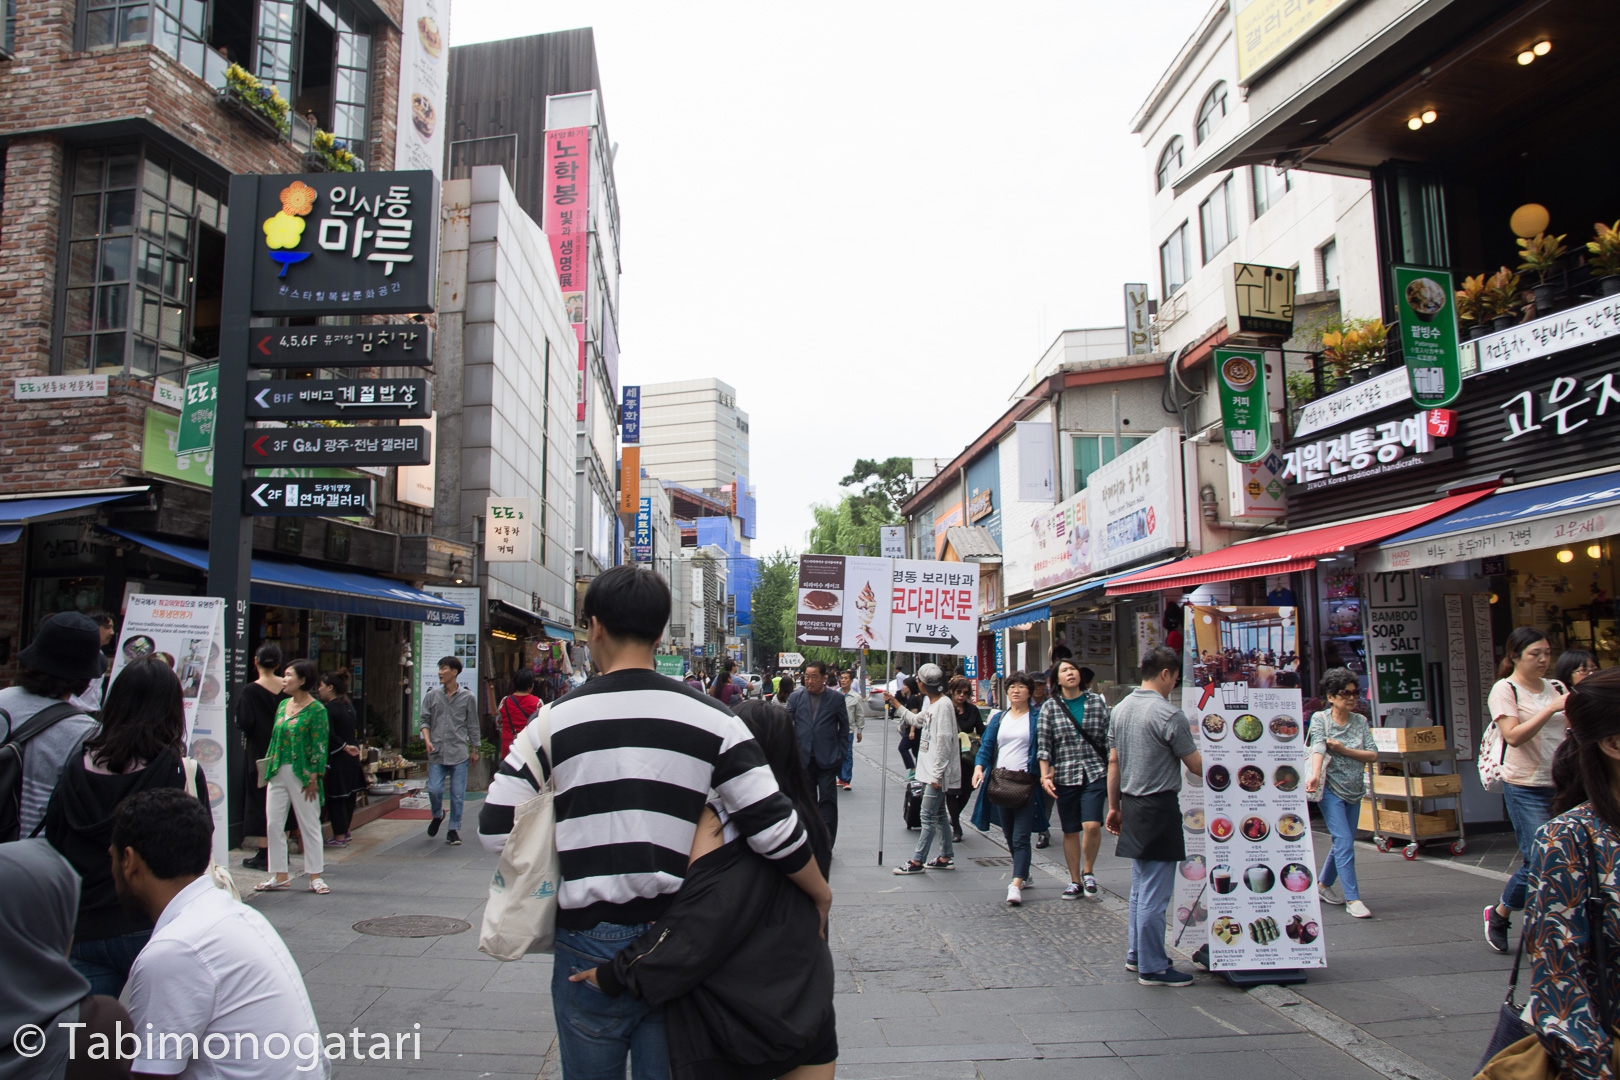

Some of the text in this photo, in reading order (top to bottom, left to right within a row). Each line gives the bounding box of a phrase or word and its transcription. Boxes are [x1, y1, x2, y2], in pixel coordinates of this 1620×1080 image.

[550, 130, 584, 139] 서양화가
[553, 140, 579, 206] 노학봉
[330, 186, 411, 218] 인사동
[560, 210, 573, 236] 빛과
[318, 217, 414, 277] 마루
[1411, 325, 1441, 339] 팥빙수
[279, 330, 419, 352] 4,5,6F 뮤지엄 김치간
[69, 380, 94, 392] 전문점
[273, 385, 416, 404] B1F 비비고 계절밥상
[1233, 396, 1249, 407] 커피
[624, 387, 638, 433] 세종화랑
[273, 440, 288, 451] 3F
[293, 438, 321, 452] G&J
[381, 438, 418, 451] 갤러리
[1281, 411, 1432, 484] 지원전통공예
[1328, 475, 1347, 485] Korea
[1347, 468, 1381, 482] traditional
[1382, 457, 1424, 473] handicrafts.
[267, 490, 282, 500] 2F
[300, 494, 365, 508] 연파갤러리
[1427, 544, 1446, 559] 비누
[1456, 534, 1496, 557] 호두까기
[1508, 527, 1532, 547] 전병
[1553, 518, 1595, 539] 고은재
[497, 545, 514, 554] 커피
[1391, 550, 1410, 558] HAND
[1391, 559, 1410, 568] MADE
[893, 570, 974, 586] 명동 보리밥과
[1373, 570, 1410, 603] 竹
[134, 598, 157, 606] 전국에서
[198, 601, 214, 609] 유명한
[892, 587, 972, 621] 코다리전문
[236, 599, 246, 639] 마루
[426, 610, 460, 623] VISA 비자카드
[1372, 610, 1418, 622] BAMBOO
[906, 622, 950, 637] TV 방송
[1372, 624, 1404, 638] SOAP
[830, 635, 840, 643] 1층
[1391, 637, 1421, 651] SALT
[1378, 657, 1405, 676] 비누
[1397, 678, 1423, 699] 소금
[1253, 693, 1264, 701] 국산
[1254, 701, 1297, 710] 수제팥빙수 전문점
[1413, 731, 1437, 744] 1865
